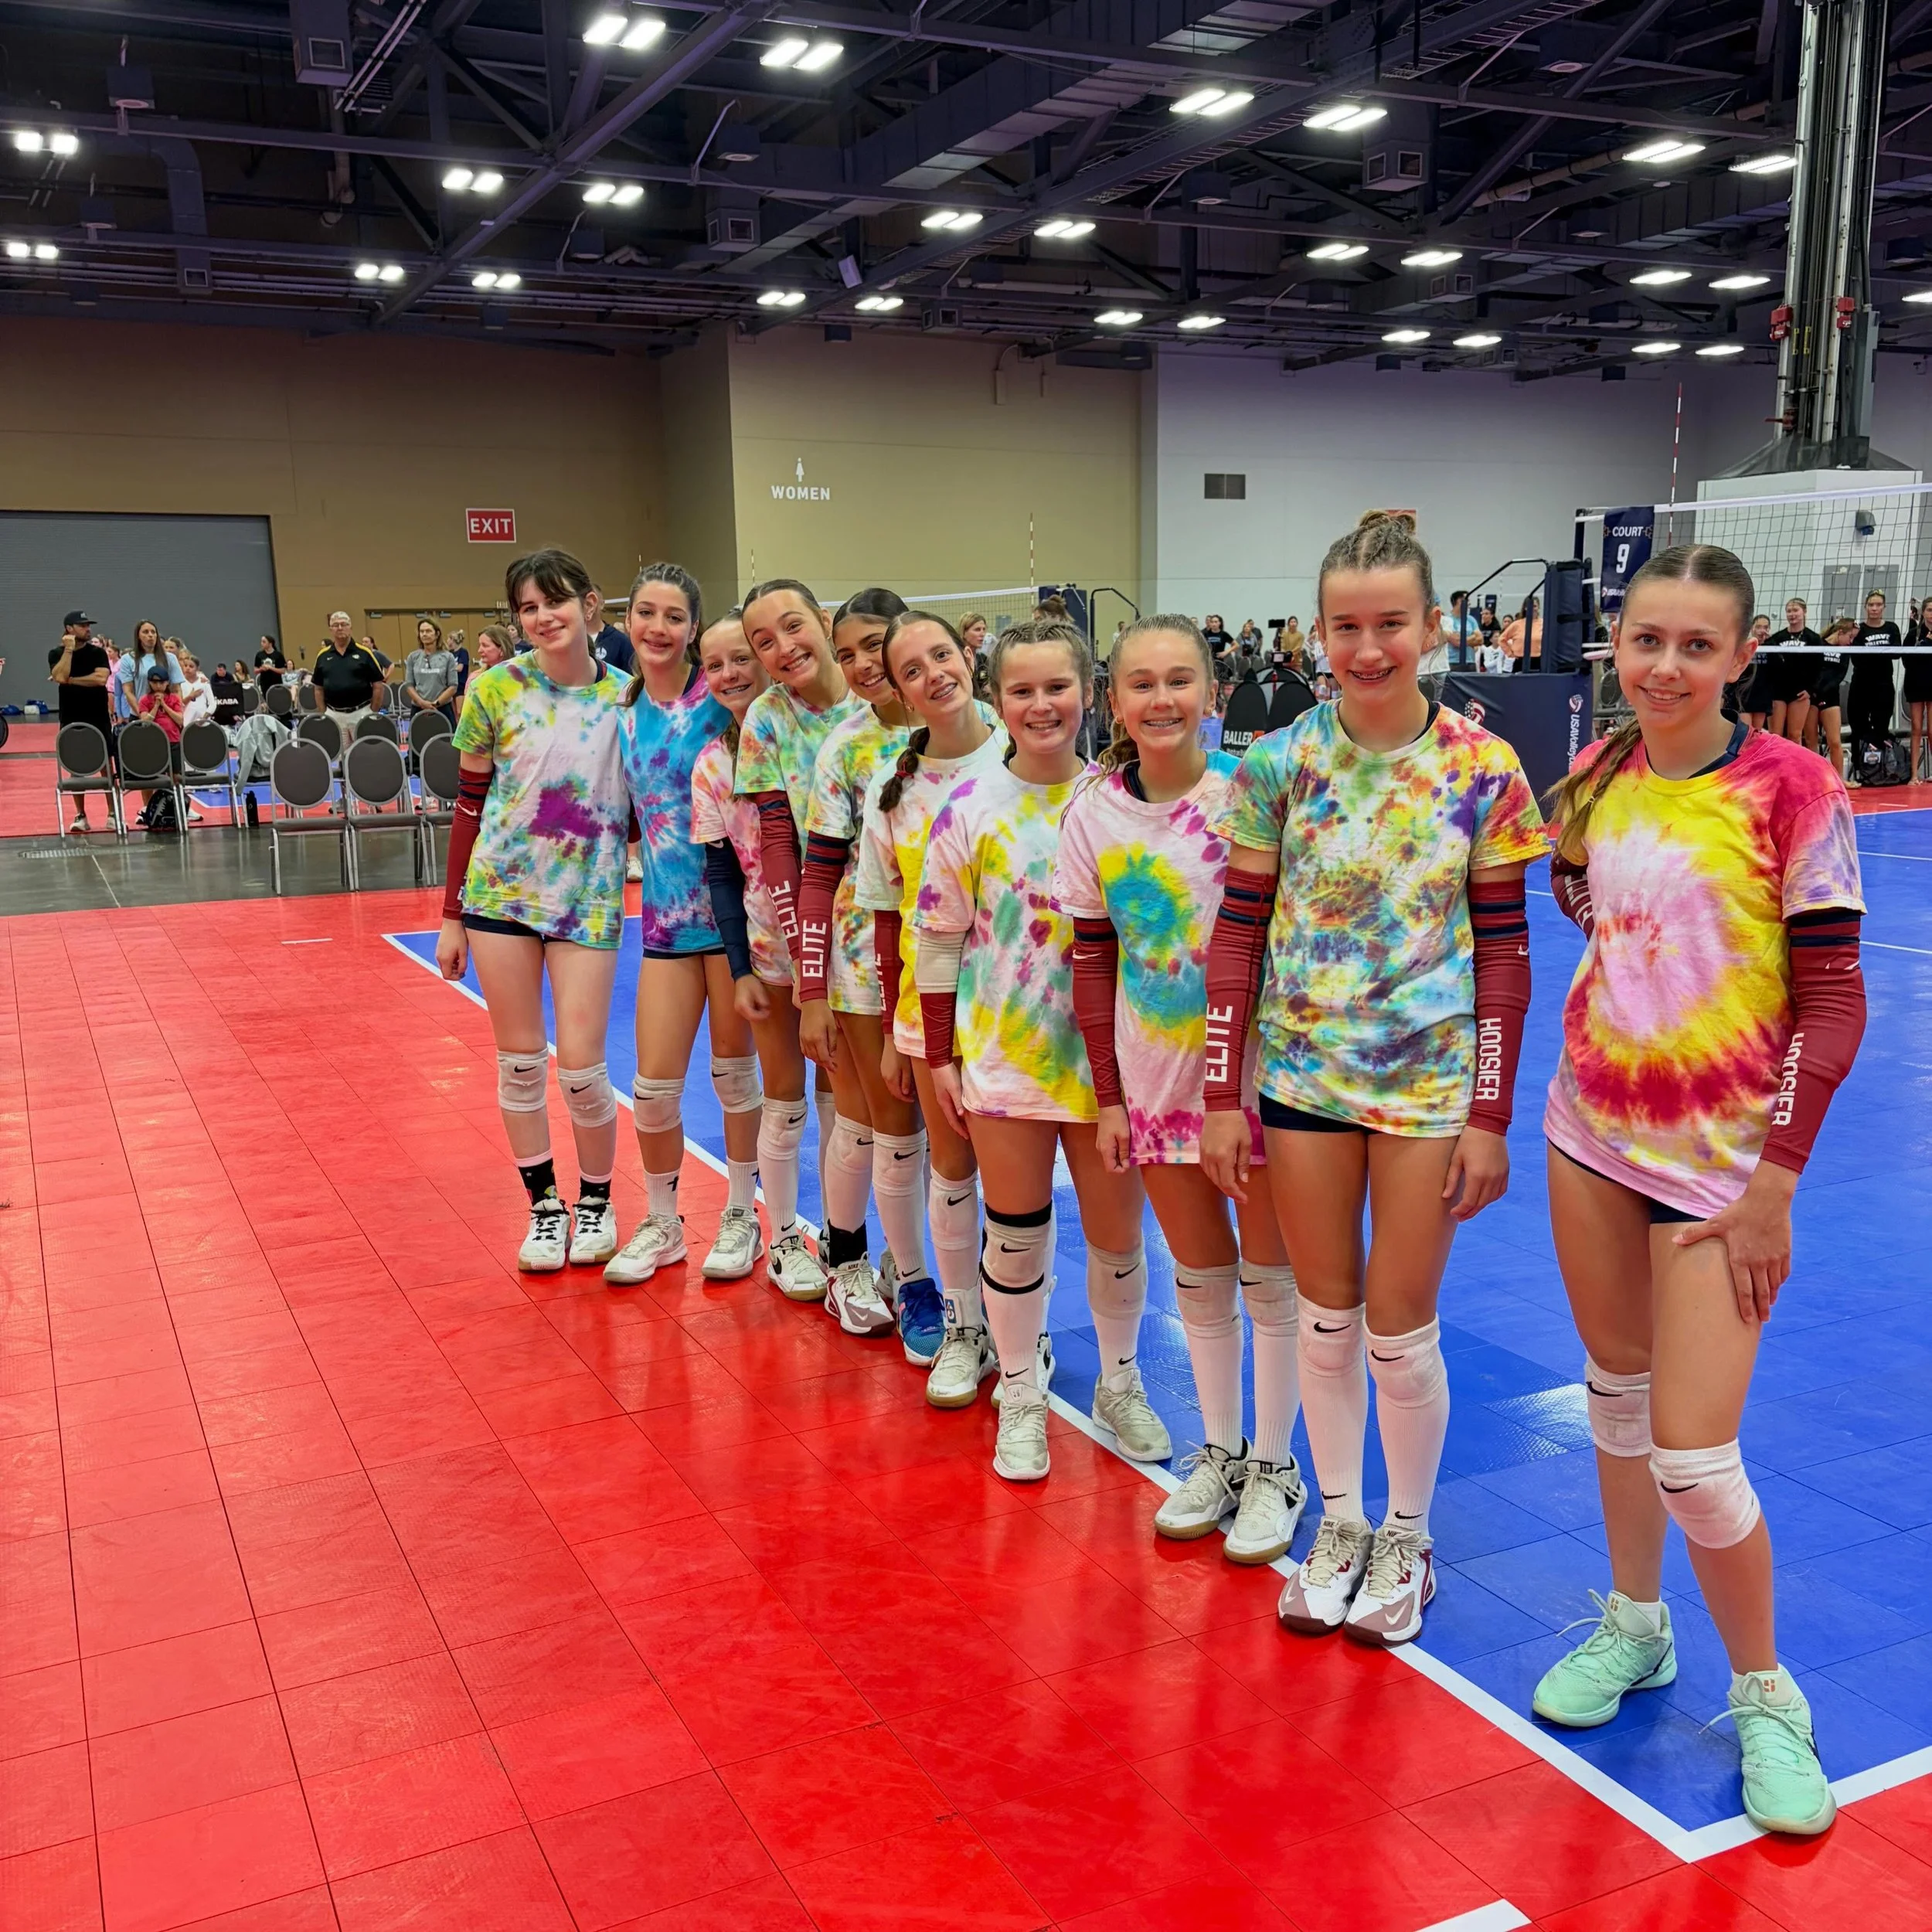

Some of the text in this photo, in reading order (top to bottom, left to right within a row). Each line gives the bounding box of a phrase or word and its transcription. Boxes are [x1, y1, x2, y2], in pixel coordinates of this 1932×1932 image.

[770, 485, 831, 500] WOMEN
[470, 518, 512, 534] EXIT
[1612, 526, 1644, 537] COURT
[1615, 543, 1630, 573] 9
[1223, 730, 1253, 746] BALLER
[767, 880, 799, 940] ELITE
[802, 920, 827, 978] ELITE
[1206, 1003, 1233, 1083] ELITE
[1475, 1018, 1502, 1100] HOOSIER
